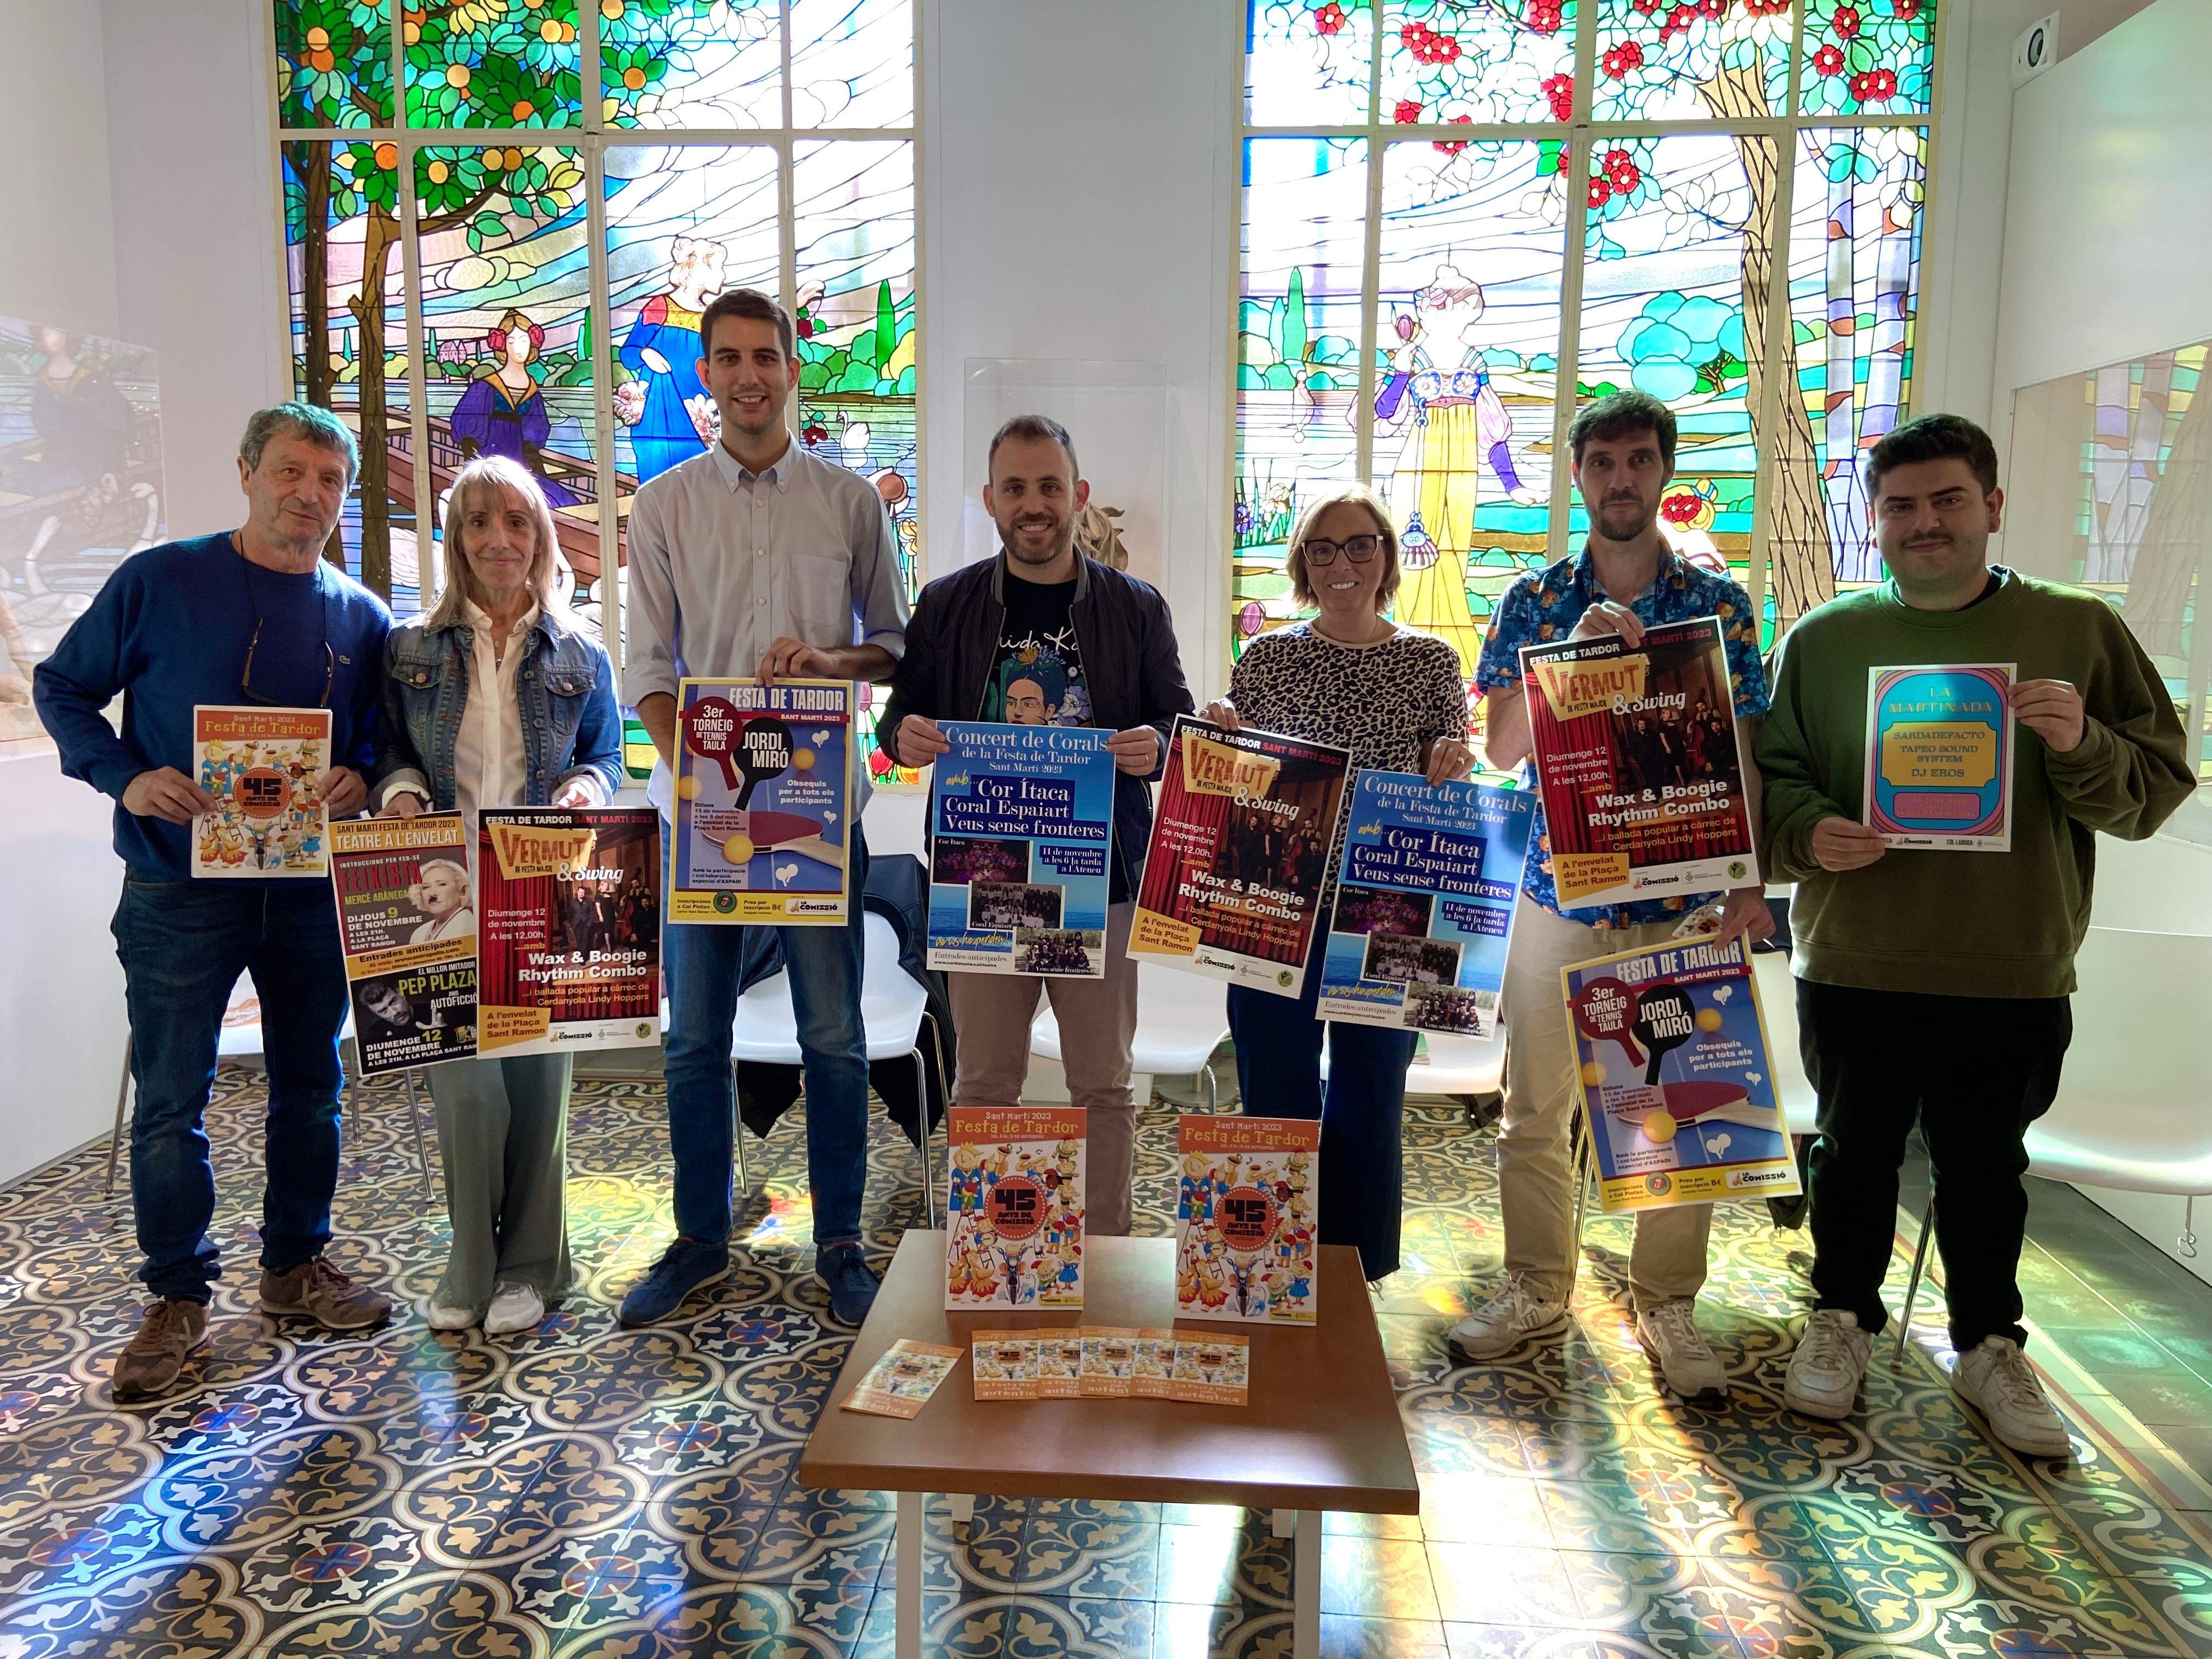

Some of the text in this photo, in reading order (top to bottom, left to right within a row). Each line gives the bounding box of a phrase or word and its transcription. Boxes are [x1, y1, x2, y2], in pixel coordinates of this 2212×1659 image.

[1529, 643, 1620, 666] FESTA DE TARDOR
[729, 687, 844, 711] FESTA DE TARDOR
[1930, 687, 1952, 697] LA
[703, 705, 724, 718] 3er
[1590, 699, 1607, 709] MAJOR
[1632, 692, 1686, 712] Swing
[1889, 702, 1993, 713] MARTINADA
[205, 721, 320, 735] Festa de Tardor
[692, 719, 733, 732] TORNEIG
[703, 732, 727, 741] TENNIS
[703, 740, 726, 751] TAULA
[743, 732, 782, 750] JORDI
[945, 727, 1108, 752] Concert de Corals
[1181, 725, 1341, 765] FESTA DE TARDOR SANT MARTÍ 2023
[752, 747, 789, 768] MIRÓ
[962, 747, 1091, 765] de la Festa de Tardor
[1931, 769, 1965, 777] EROS
[787, 780, 826, 788] Obsequis
[978, 777, 1070, 802] Cor Ítaca
[1365, 776, 1527, 814] Concert de Corals
[1595, 780, 1728, 809] Wax & Boogie
[946, 797, 1069, 820] Coral Espaiart
[1251, 794, 1300, 821] Swing
[1588, 798, 1730, 830] Rhythm Combo
[337, 825, 354, 834] SANT
[357, 822, 378, 832] MARTÍ
[380, 823, 399, 831] FESTA
[601, 815, 628, 823] MARTÍ
[944, 814, 1105, 838] Veus sense fronteres
[336, 830, 459, 849] TEATRE A L'ENVELAT
[1388, 830, 1481, 859] Cor Ítaca
[1355, 846, 1477, 876] Coral Espaiart
[575, 865, 624, 884] Swing
[1352, 863, 1512, 899] Veus sense fronteres
[1590, 874, 1626, 884] Ramon
[1190, 869, 1305, 906] Wax & Boogie
[1178, 883, 1301, 922] Rhythm Combo
[347, 907, 398, 923] DIJOUS 9
[349, 916, 422, 931] DE NOVEMBRE
[1190, 916, 1298, 948] Cerdanyola Lindy Hoppers
[359, 939, 462, 962] Entrades anticipades
[528, 949, 647, 965] Wax & Boogie
[1616, 941, 1741, 983] FESTA DE TARDOR
[398, 970, 477, 996] PEP PLAZA
[518, 965, 647, 983] Rhythm Combo
[431, 992, 477, 1009] AUTOFICCIÓ
[1583, 996, 1627, 1017] TORNEIG
[1640, 997, 1681, 1023] JORDI
[1598, 1010, 1622, 1023] TENNIS
[1652, 1012, 1693, 1039] MIRÓ
[487, 1030, 509, 1038] Sant
[1598, 1021, 1623, 1033] TAULA
[366, 1029, 442, 1052] DIUMENGE 12
[368, 1042, 441, 1060] DE NOVEMBRE
[985, 1111, 1005, 1120] Sant
[955, 1120, 1079, 1133] Festa de Tardor
[1185, 1127, 1310, 1146] Festa de Tardor
[995, 1189, 1036, 1210] 45
